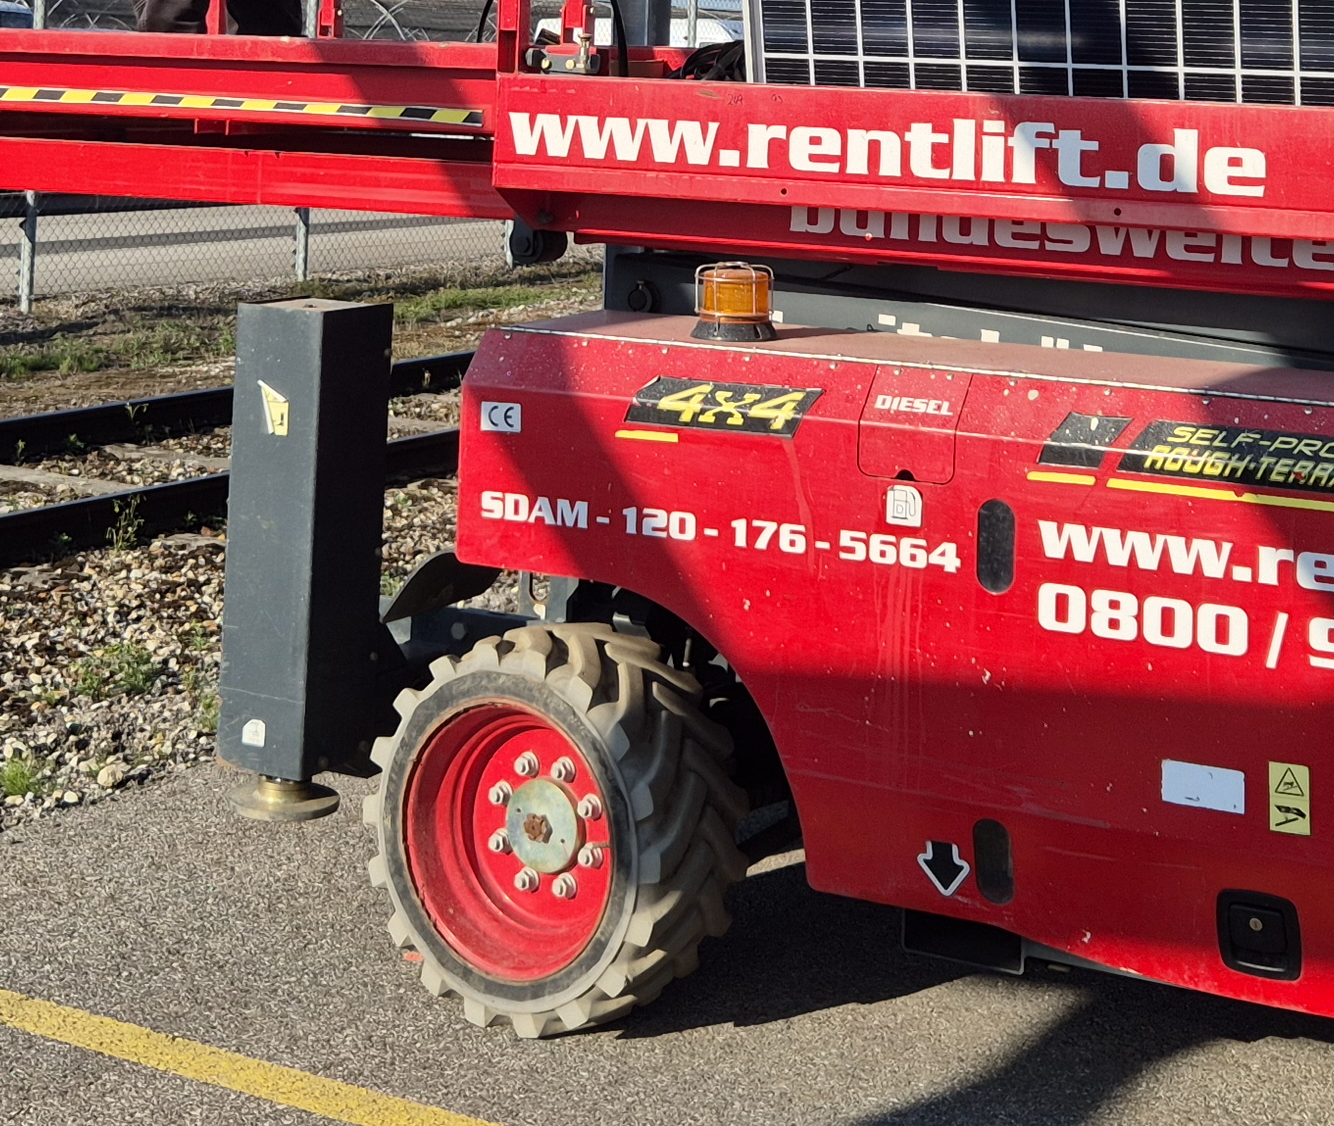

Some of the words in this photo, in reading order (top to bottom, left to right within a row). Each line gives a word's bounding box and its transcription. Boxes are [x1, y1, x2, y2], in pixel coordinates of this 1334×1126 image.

[508, 111, 1267, 199] www.rentlift.de
[488, 405, 515, 428] CE
[874, 393, 954, 417] DIESEL
[481, 490, 589, 529] SDAM
[622, 506, 697, 542] 120
[731, 518, 807, 554] 176
[839, 529, 961, 573] 5664
[1038, 581, 1250, 657] 0800
[1265, 612, 1289, 669] /
